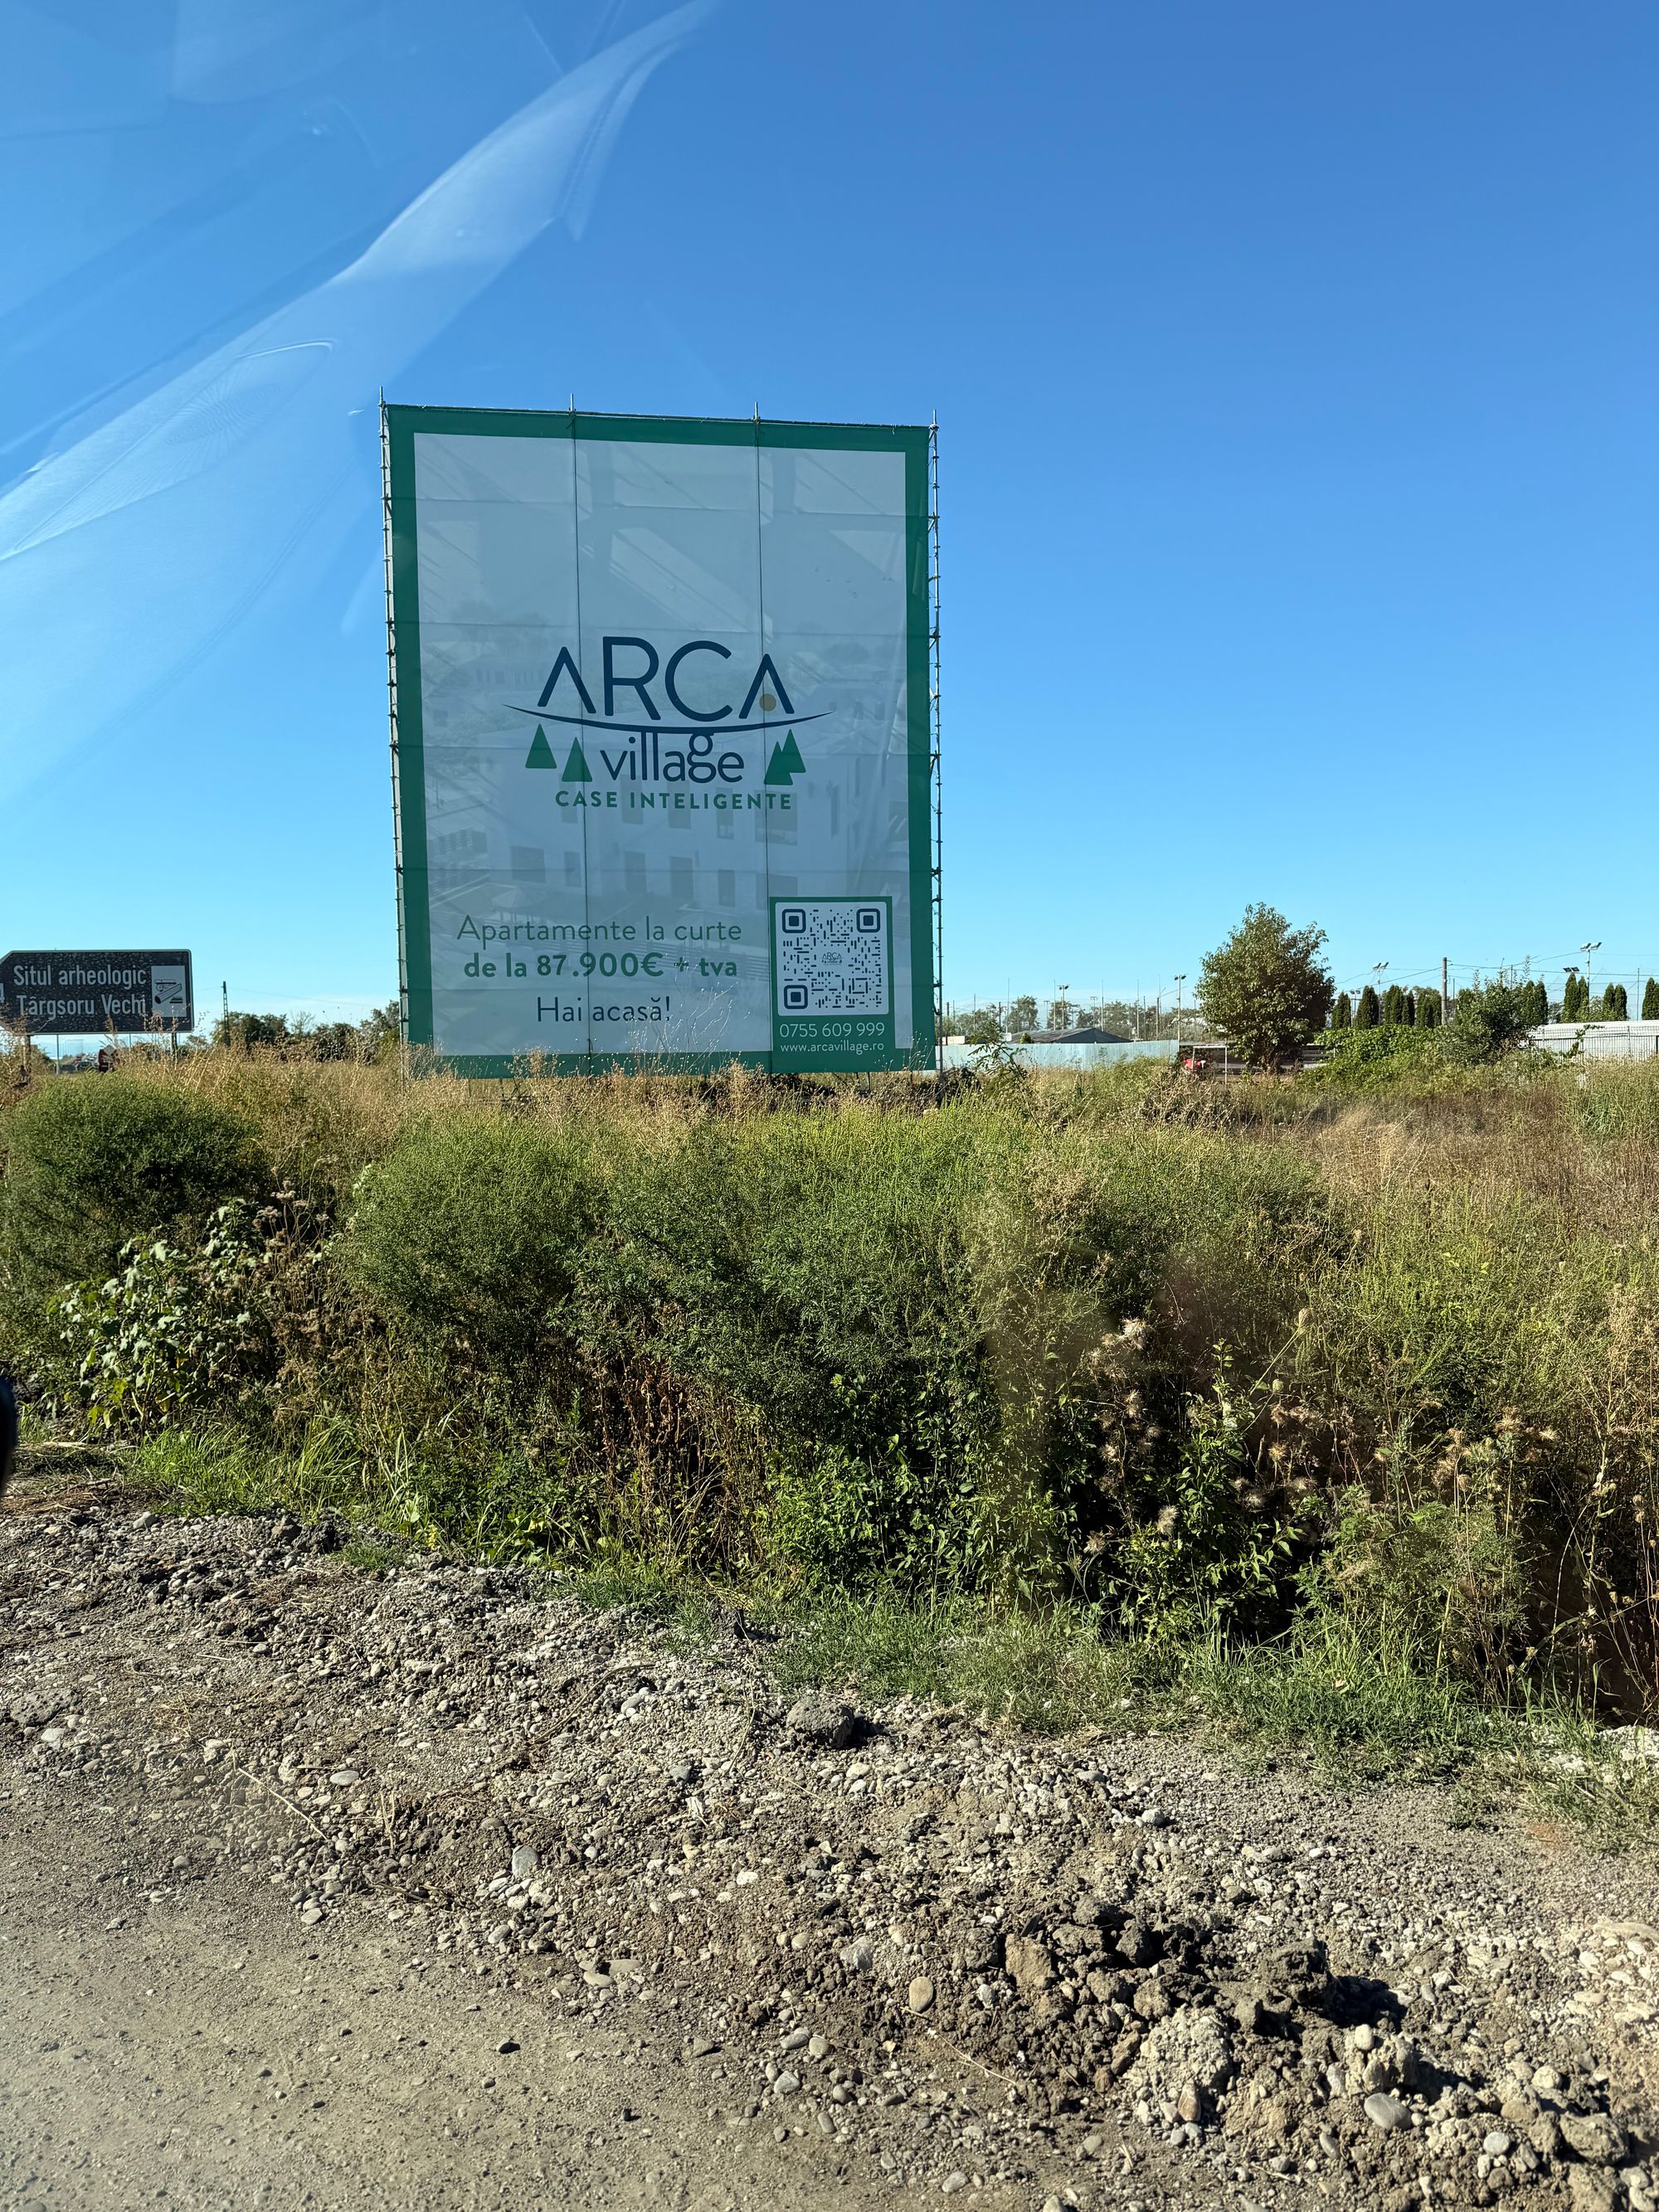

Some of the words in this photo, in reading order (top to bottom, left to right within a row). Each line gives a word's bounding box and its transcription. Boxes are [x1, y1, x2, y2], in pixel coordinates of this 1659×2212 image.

[537, 636, 795, 722] ARCA
[600, 731, 745, 784] village
[555, 790, 617, 809] CASE
[630, 792, 791, 809] INTELIGENTE
[456, 914, 636, 950] Apartamente
[645, 915, 664, 941] la
[674, 921, 742, 941] curte
[13, 965, 51, 986] Situl
[58, 965, 147, 989] arheologic
[464, 952, 497, 978] de
[506, 952, 528, 978] la
[537, 952, 664, 978] 87.900€
[674, 956, 689, 973] +
[698, 959, 737, 977] tva
[100, 994, 146, 1015] Vechi
[538, 996, 581, 1023] Hai
[591, 995, 671, 1022] acasă!
[779, 1023, 818, 1038] 0755
[821, 1023, 853, 1037] 609
[856, 1022, 885, 1037] 999
[780, 1039, 885, 1055] www.arcavillage.ro
